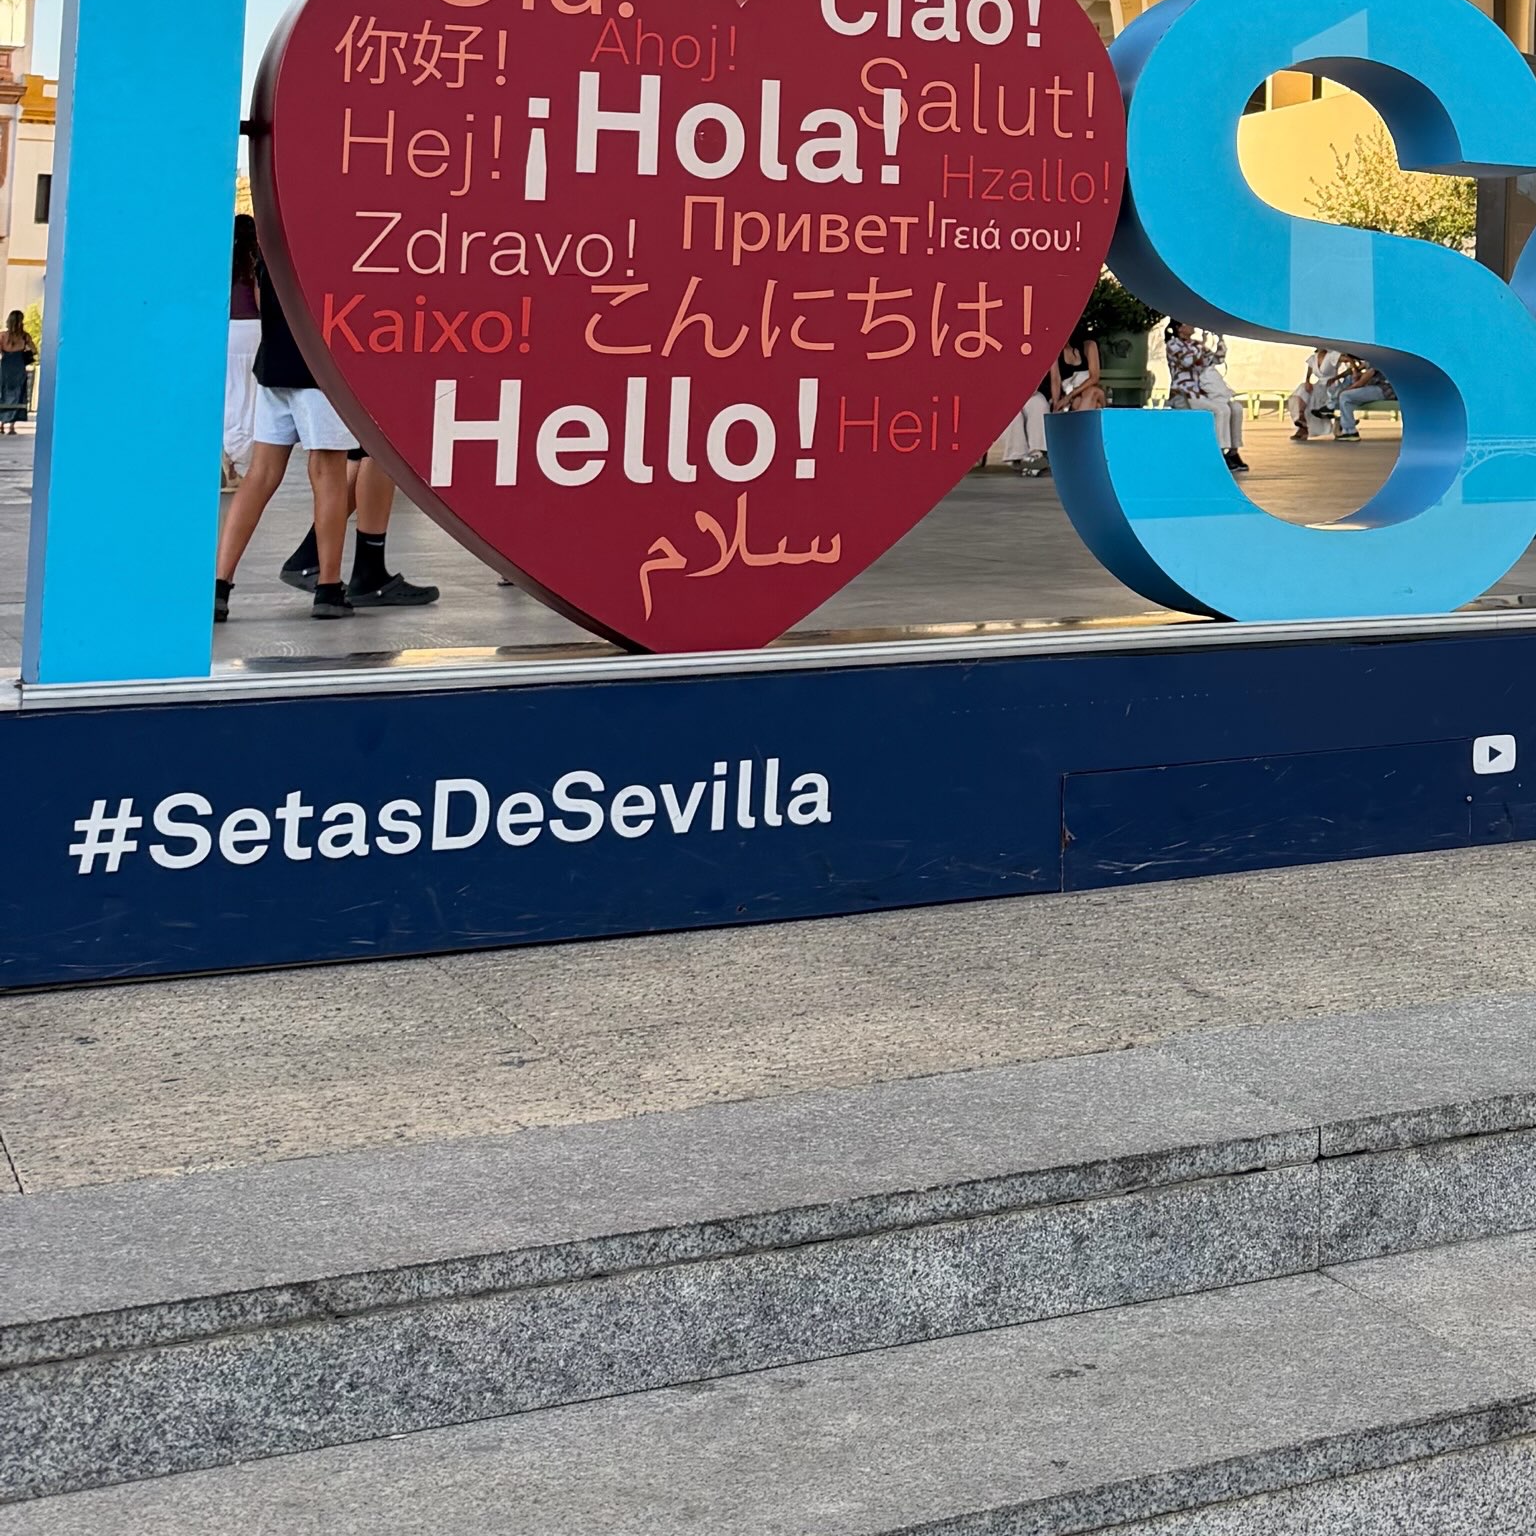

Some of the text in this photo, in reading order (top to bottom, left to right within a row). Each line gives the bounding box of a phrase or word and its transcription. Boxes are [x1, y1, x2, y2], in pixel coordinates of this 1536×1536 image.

[334, 14, 508, 89] 你好!
[590, 17, 738, 82] Ahoj!
[524, 70, 902, 201] ¡Hola!
[857, 57, 1095, 140] Salut!
[342, 107, 502, 197] Hej!
[942, 154, 1111, 205] Hzallo!
[352, 211, 636, 278] Zdravo!
[682, 195, 936, 265] Привет!
[940, 217, 1082, 252] Γειά σου!
[321, 293, 532, 354] Kaixo!
[585, 275, 1034, 361] こんにちは!
[431, 376, 820, 488] Hello!
[838, 395, 961, 453] Hei!
[638, 491, 842, 621] سلام
[67, 757, 833, 875] #SetasDeSevilla
